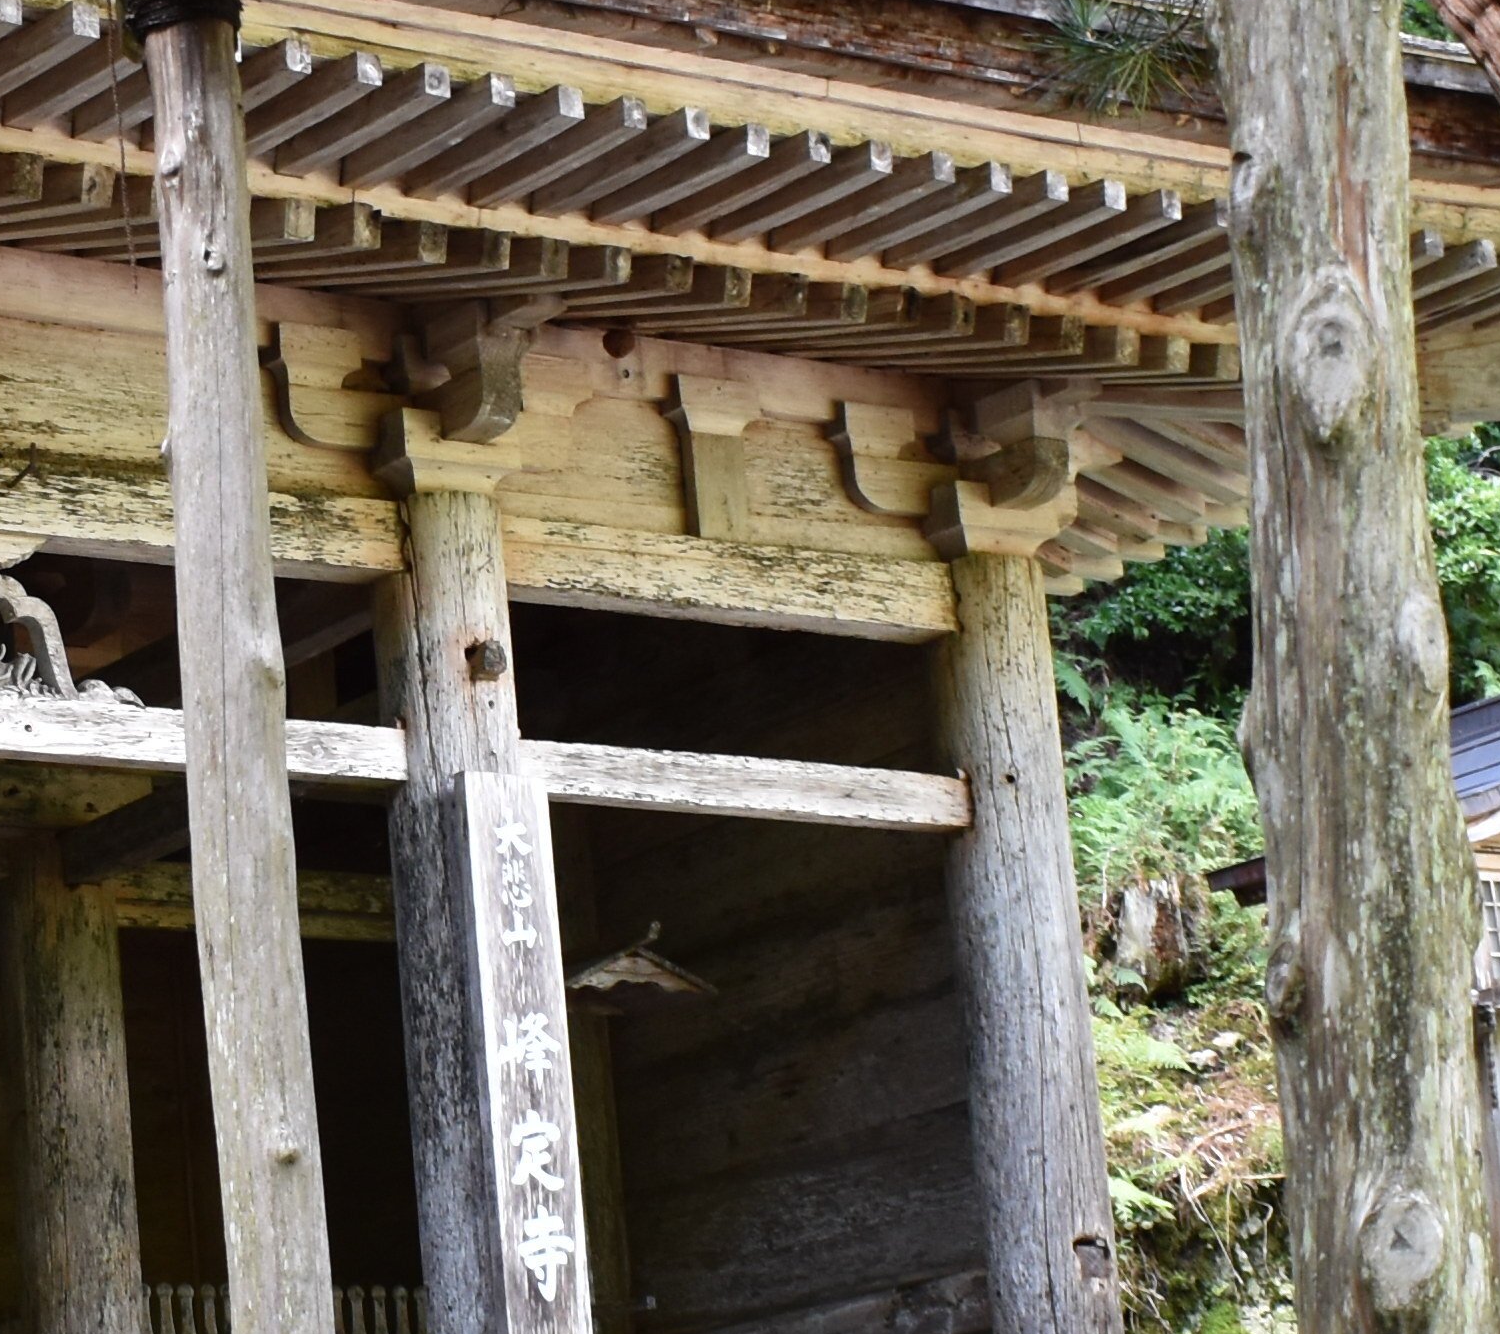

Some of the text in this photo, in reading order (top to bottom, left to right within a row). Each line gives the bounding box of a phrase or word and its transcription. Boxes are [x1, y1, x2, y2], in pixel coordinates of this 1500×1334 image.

[493, 807, 575, 1302] 大悲山 峰定寺
